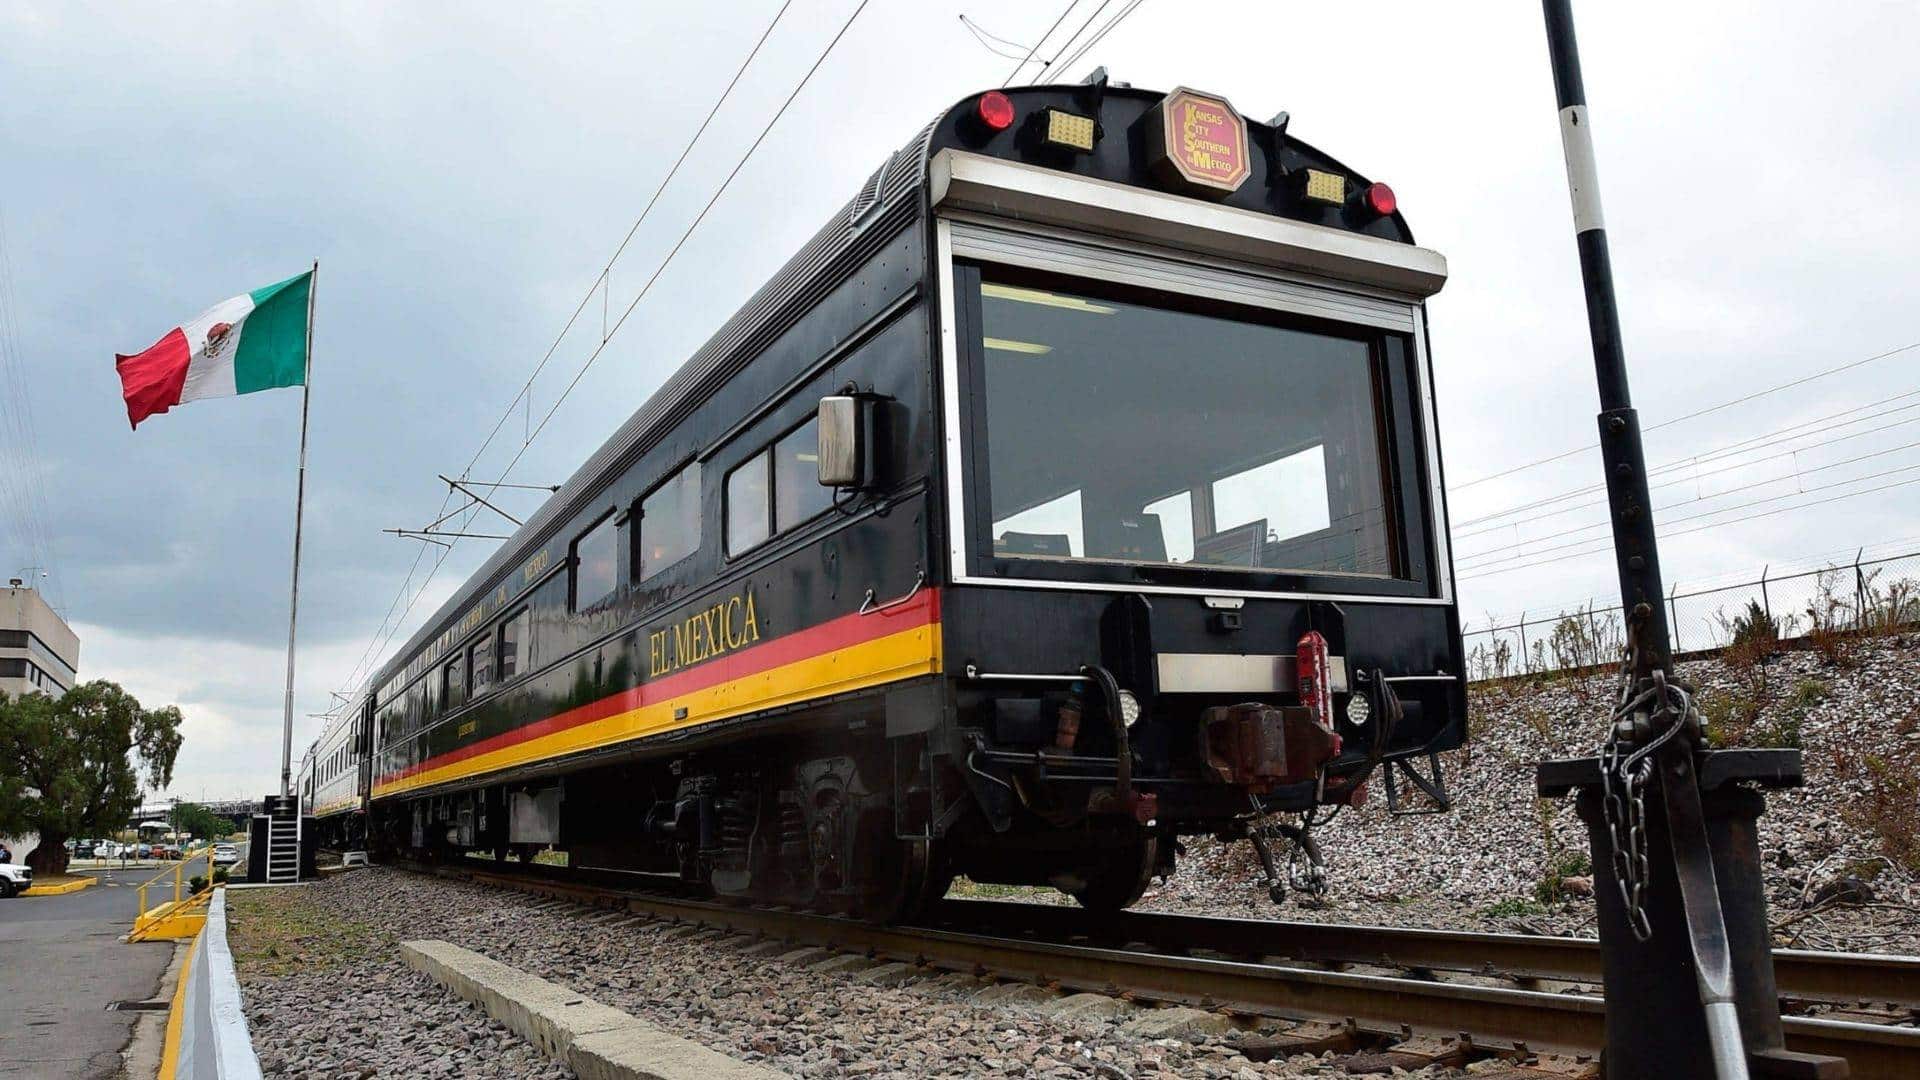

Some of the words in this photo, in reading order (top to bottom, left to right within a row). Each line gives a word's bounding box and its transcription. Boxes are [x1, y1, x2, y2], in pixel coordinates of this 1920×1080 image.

[1185, 103, 1223, 125] KANSAS
[1184, 122, 1208, 137] CITY
[650, 630, 670, 678] EL
[674, 591, 760, 670] MEXICA
